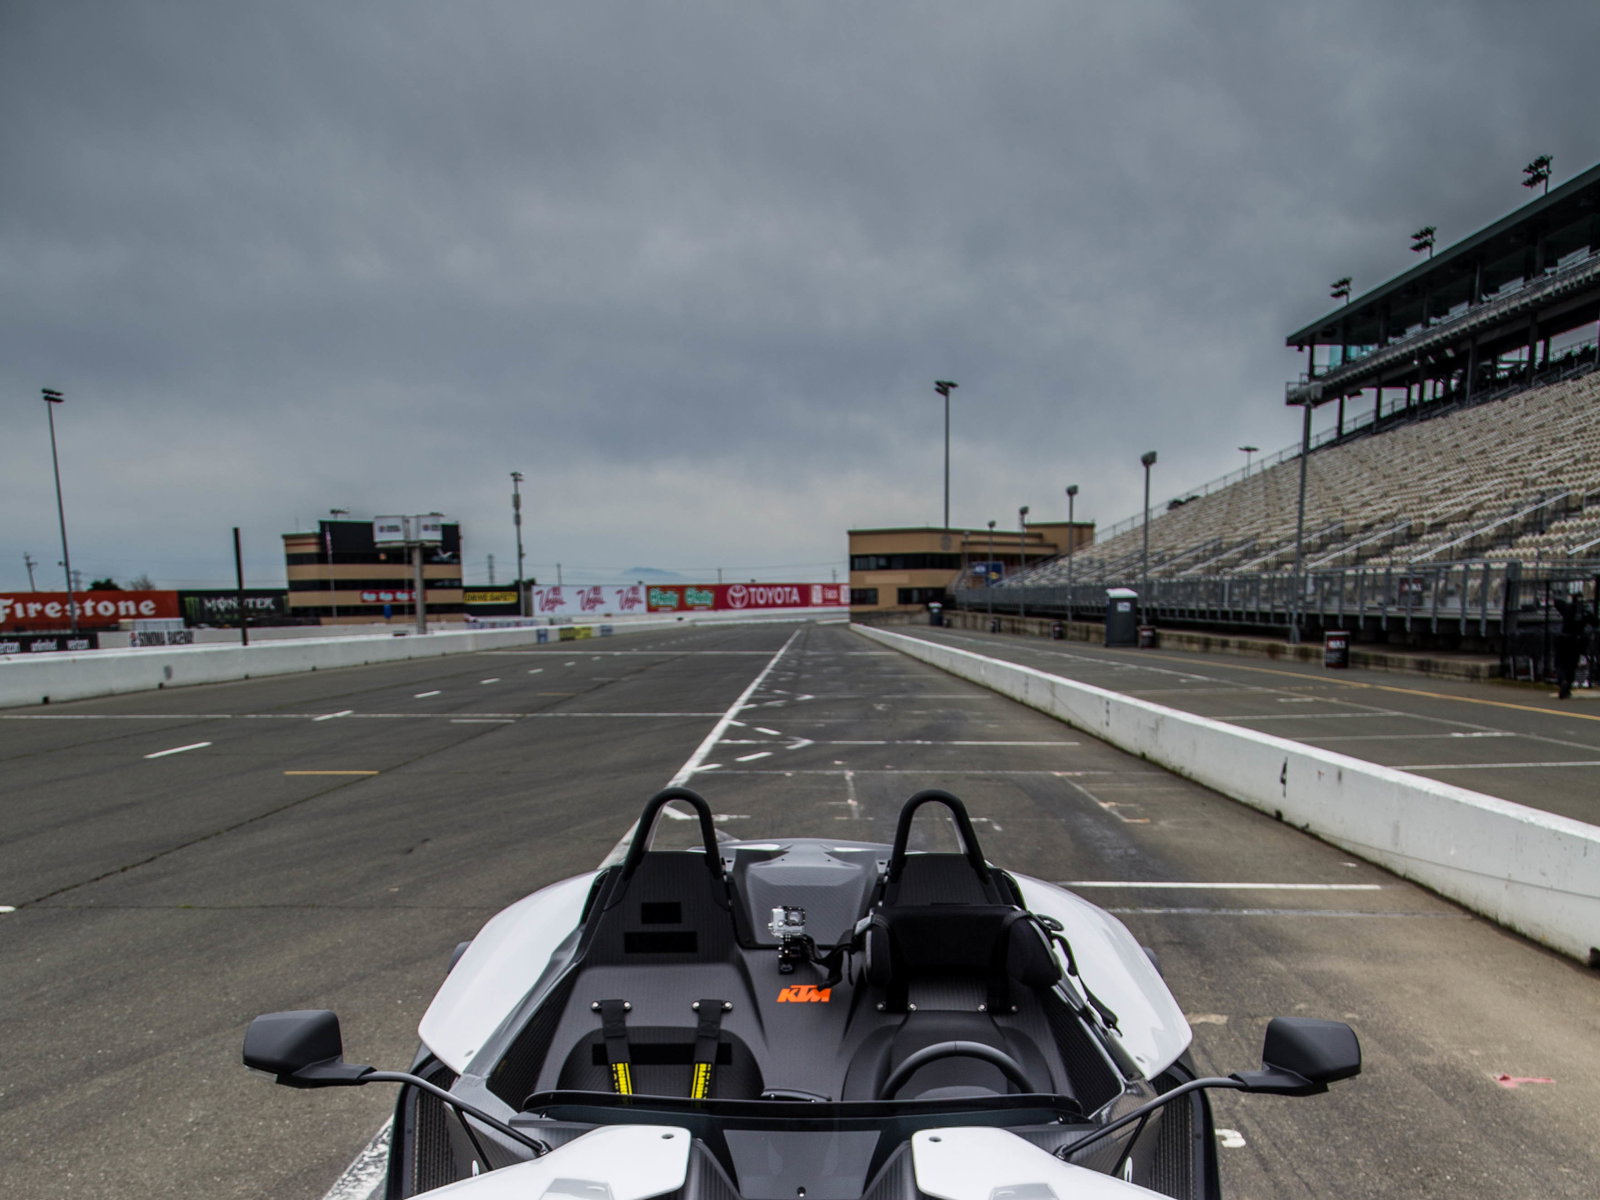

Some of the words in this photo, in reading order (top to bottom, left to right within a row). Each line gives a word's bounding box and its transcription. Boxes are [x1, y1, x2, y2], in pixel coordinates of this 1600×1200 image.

[203, 596, 276, 612] MONTER
[749, 586, 800, 605] TOYOTA
[0, 598, 156, 624] Firestone
[777, 985, 832, 1002] KTM
